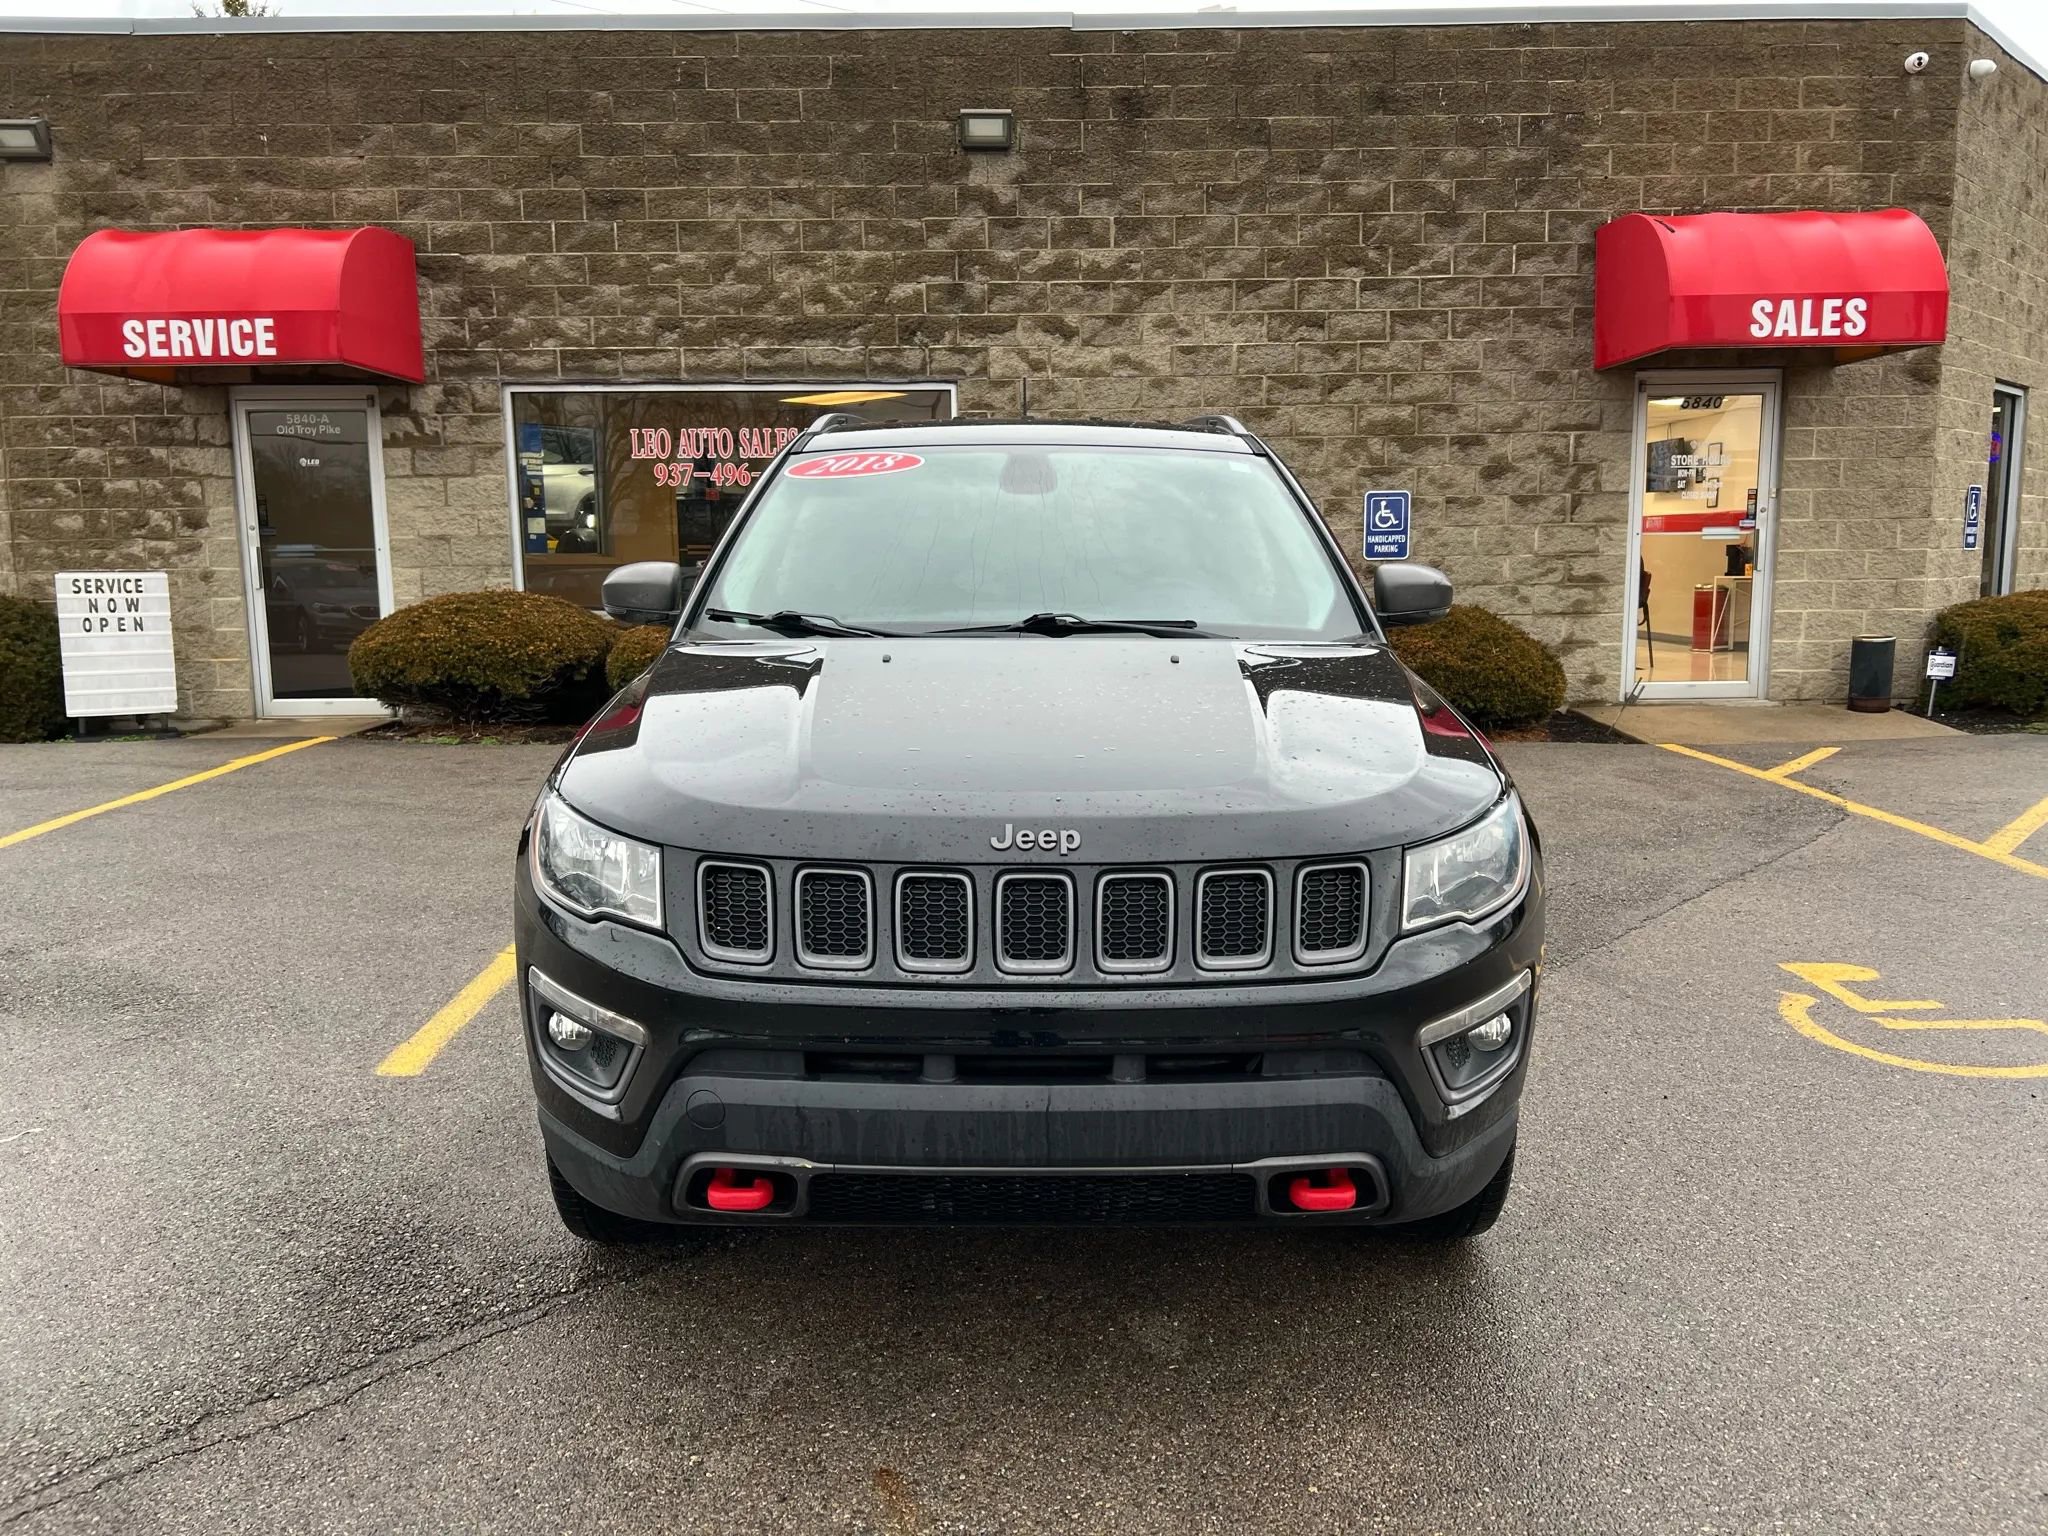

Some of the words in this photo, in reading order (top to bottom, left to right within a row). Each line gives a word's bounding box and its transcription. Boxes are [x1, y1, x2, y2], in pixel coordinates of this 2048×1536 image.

[1750, 297, 1868, 338] SALES
[122, 318, 277, 358] SERVICE
[1681, 397, 1723, 409] 5840
[286, 414, 329, 424] 5840-A
[276, 425, 295, 434] Old
[296, 425, 317, 436] Troy
[319, 425, 341, 434] Pike
[630, 428, 671, 459] LEO
[677, 428, 734, 459] AUTO
[805, 454, 904, 475] 2018
[1670, 455, 1699, 466] STORE
[1367, 534, 1406, 543] HANDICAPPED
[1374, 545, 1399, 553] PARKING
[71, 578, 144, 595] SERVICE
[88, 597, 140, 613] NOW
[82, 616, 144, 632] OPEN
[990, 823, 1081, 856] Jeep
